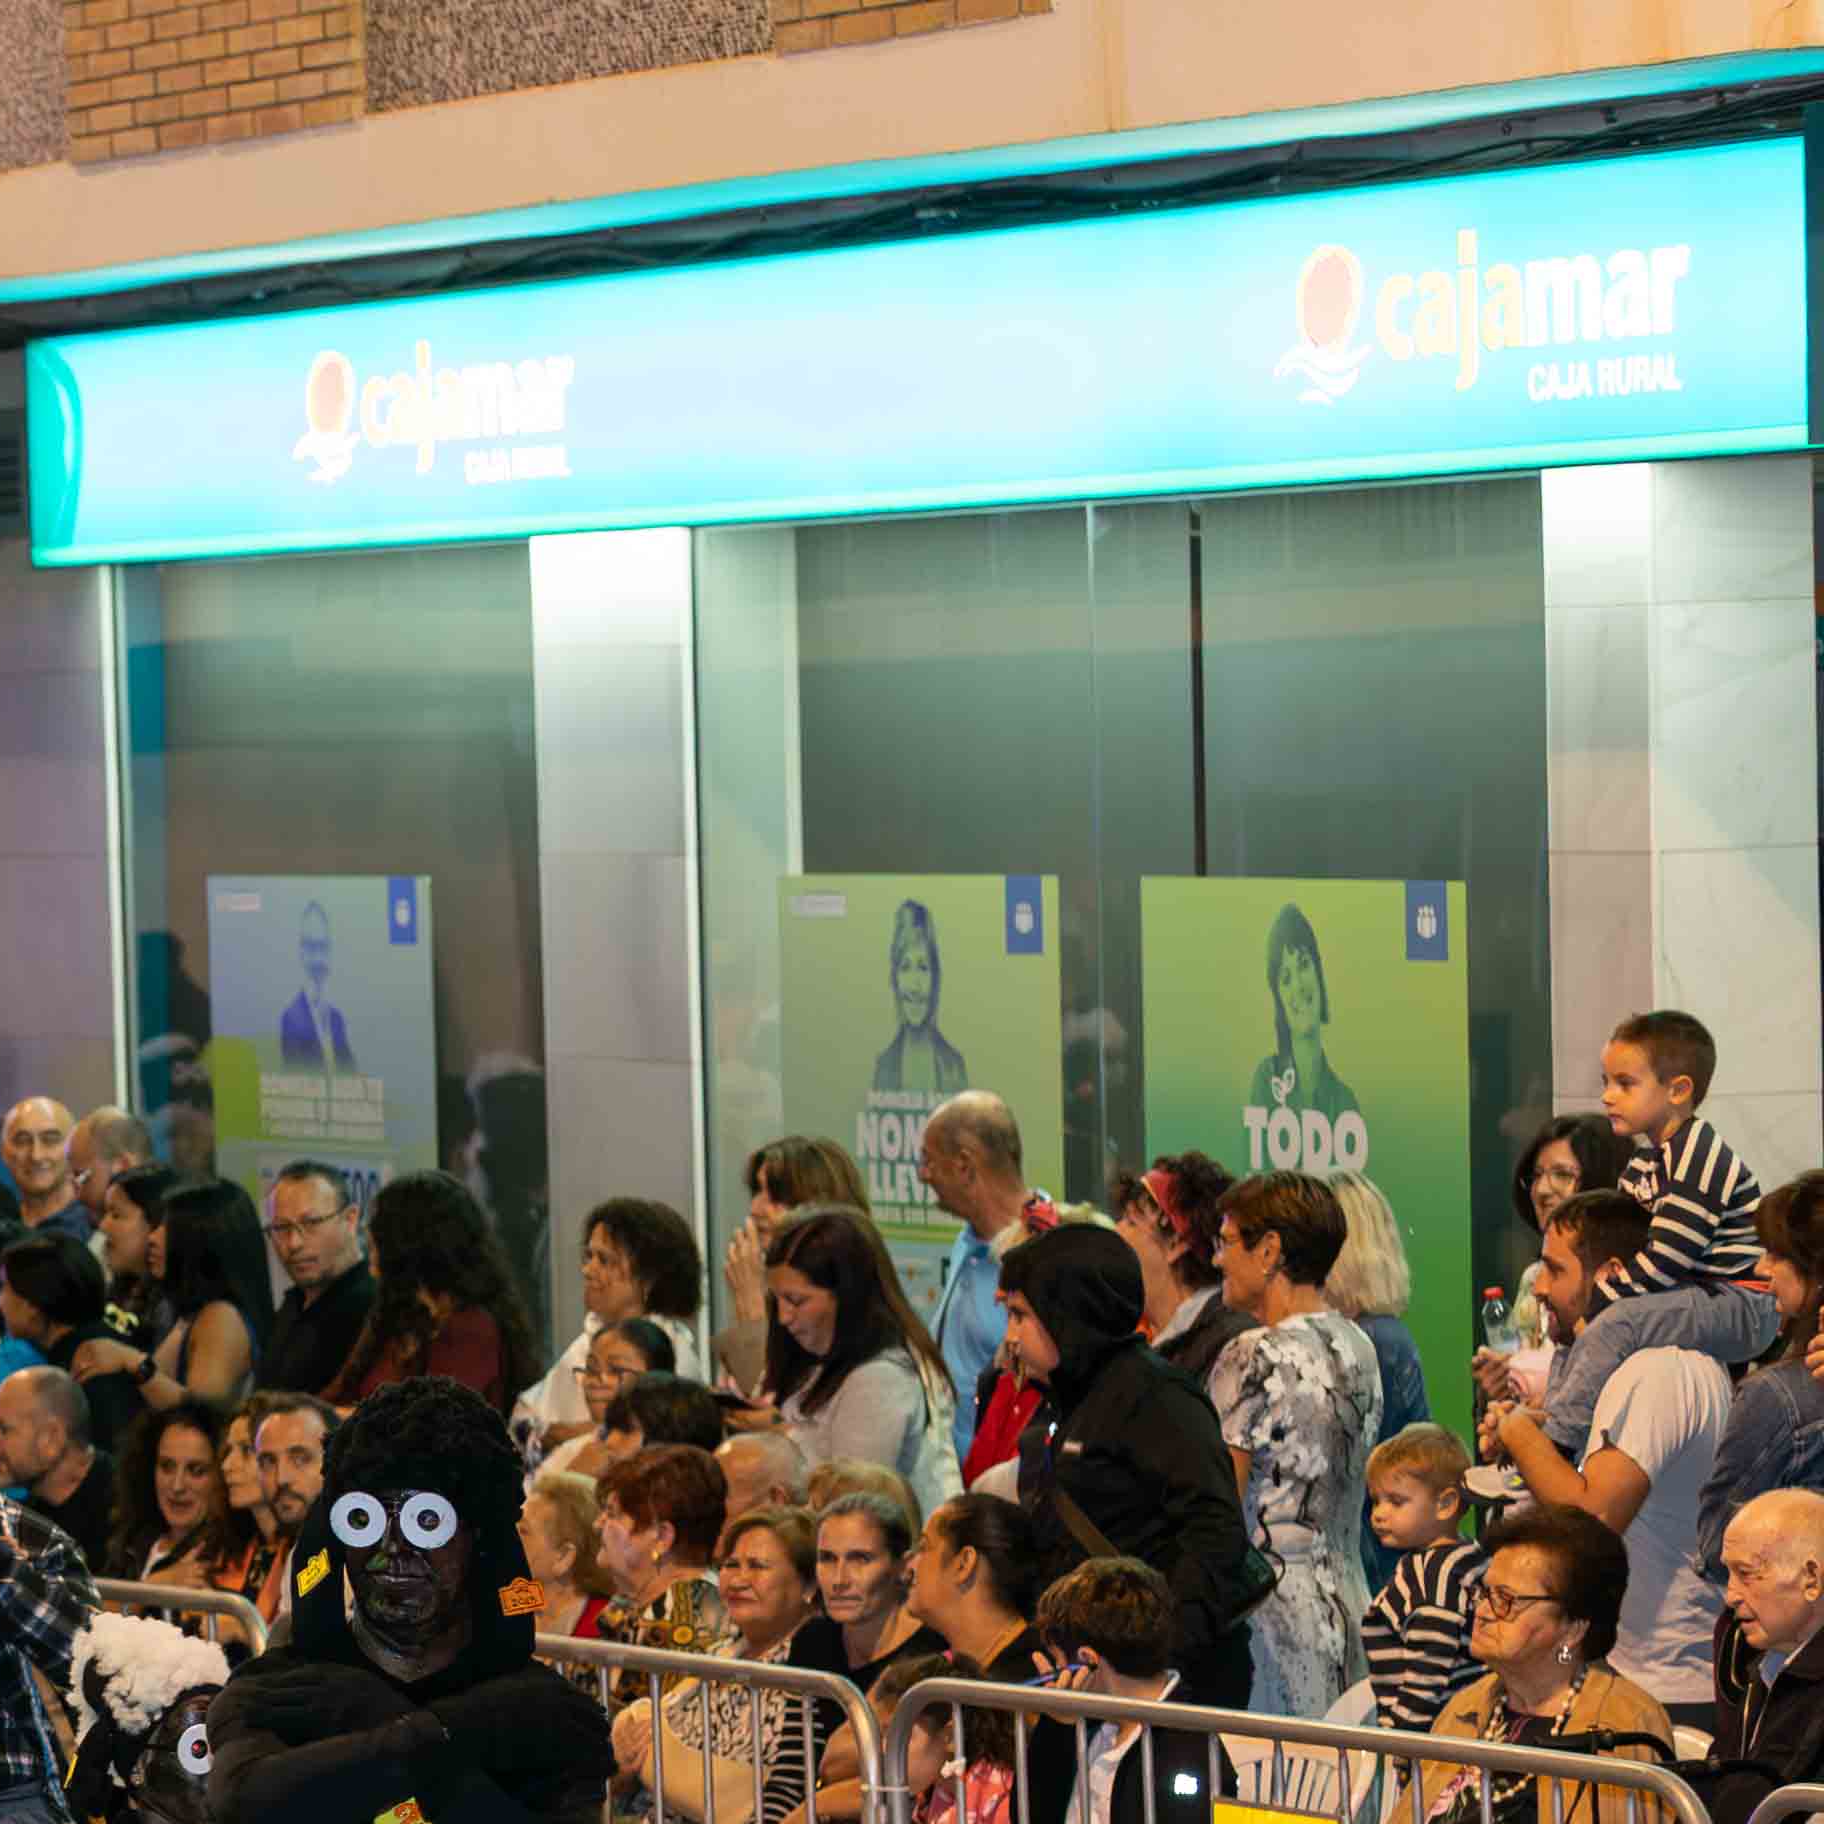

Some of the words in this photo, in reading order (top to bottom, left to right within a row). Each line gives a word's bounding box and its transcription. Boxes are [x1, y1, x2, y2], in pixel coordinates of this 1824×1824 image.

[1375, 228, 1690, 392] cajamar
[360, 338, 575, 474] cajamar
[1527, 359, 1592, 401] CAJA
[1597, 351, 1681, 395] RURAL
[1243, 1106, 1368, 1170] TODO
